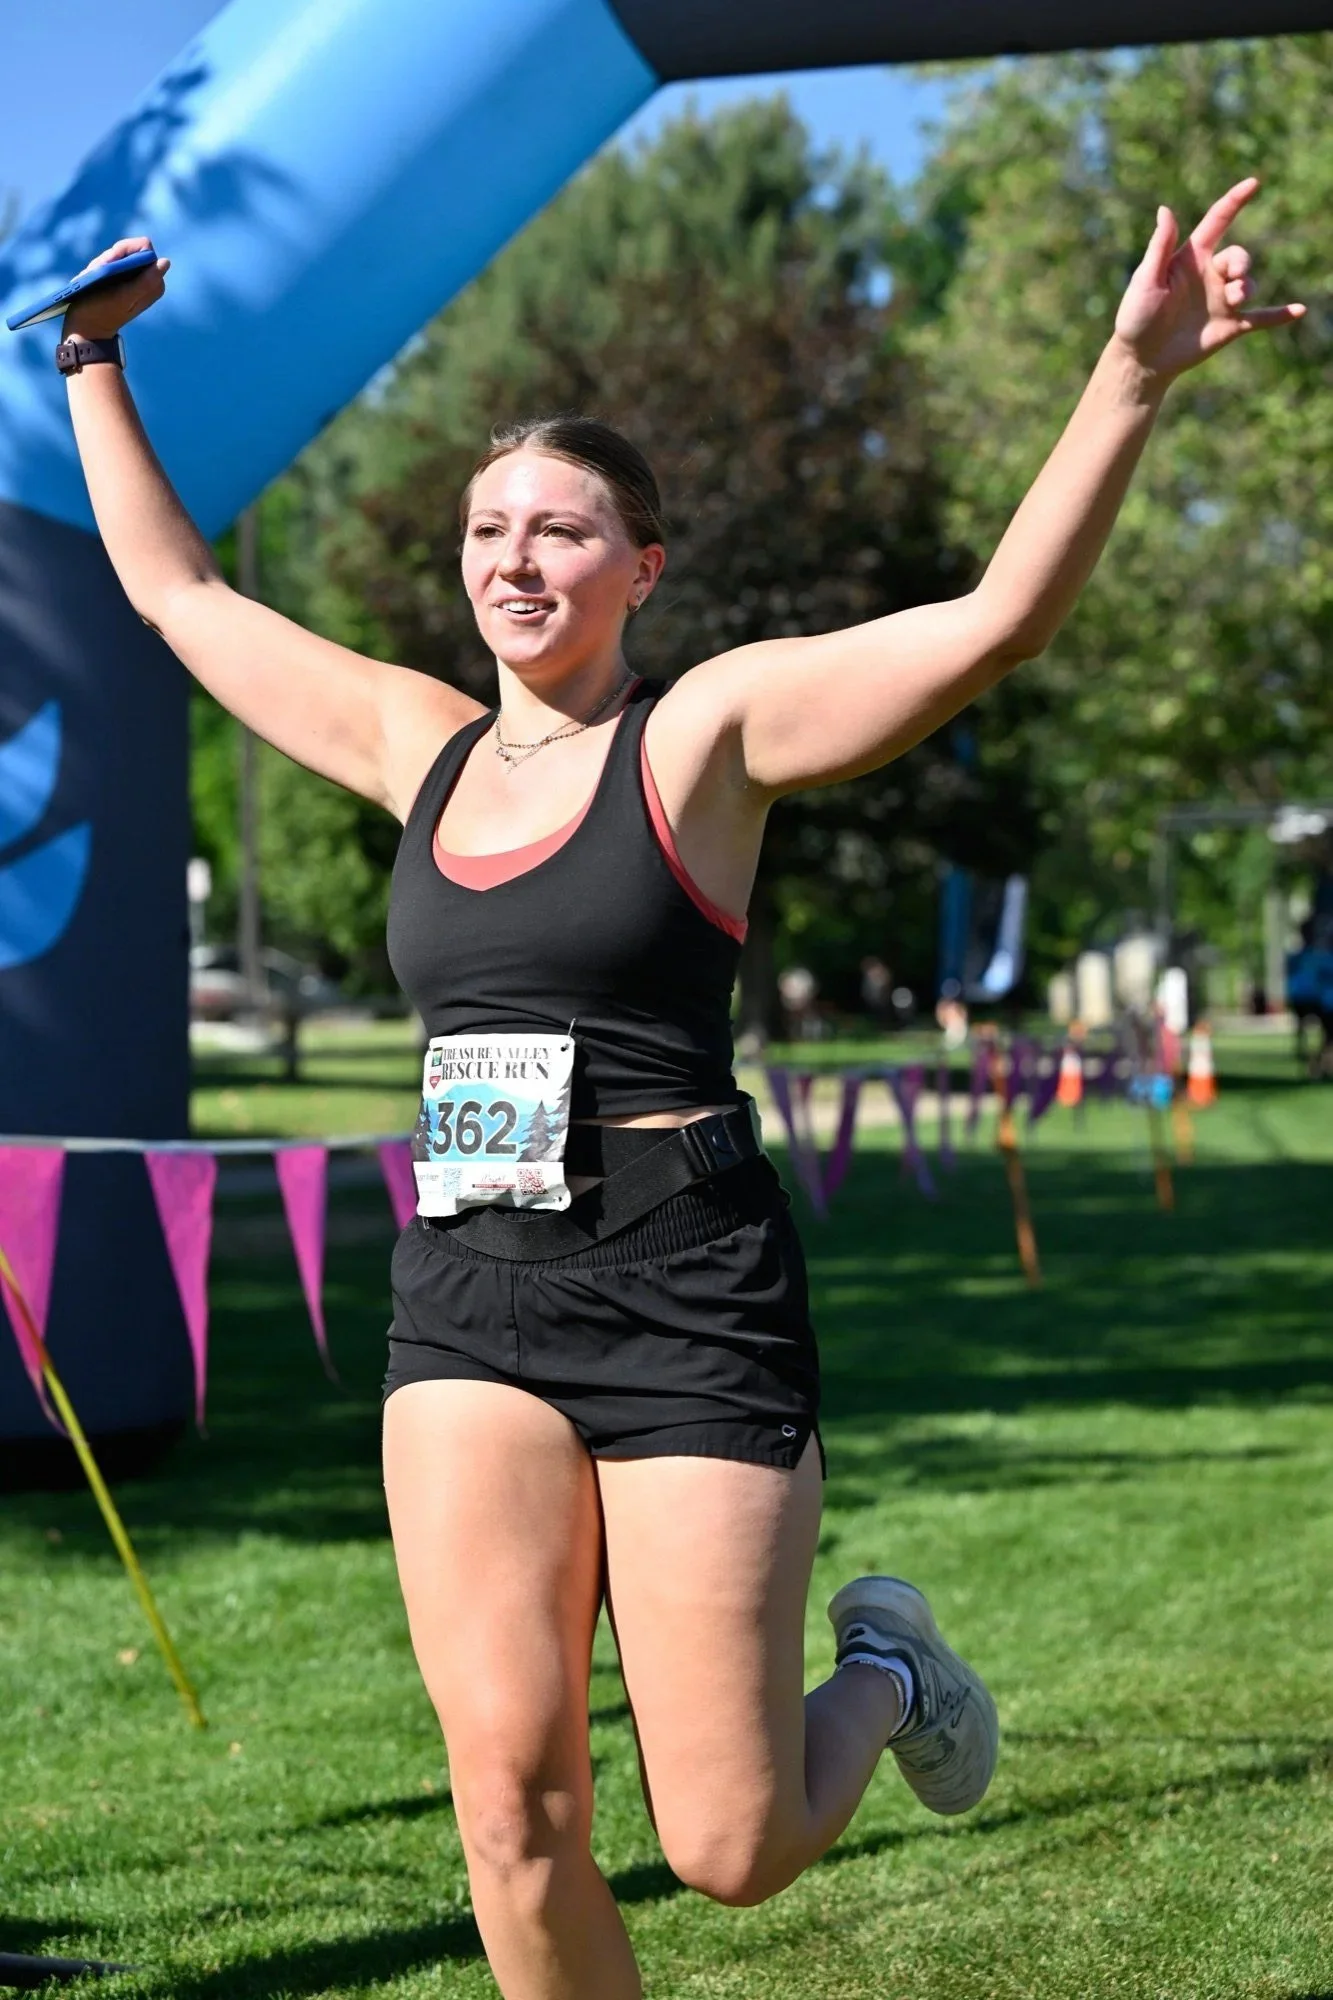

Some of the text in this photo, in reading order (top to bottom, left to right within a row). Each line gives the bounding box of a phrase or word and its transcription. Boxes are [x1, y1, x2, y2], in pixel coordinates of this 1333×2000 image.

[443, 1046, 551, 1060] TREASURE VALLEY
[442, 1061, 551, 1080] RESCUE RUN
[432, 1100, 517, 1155] 362
